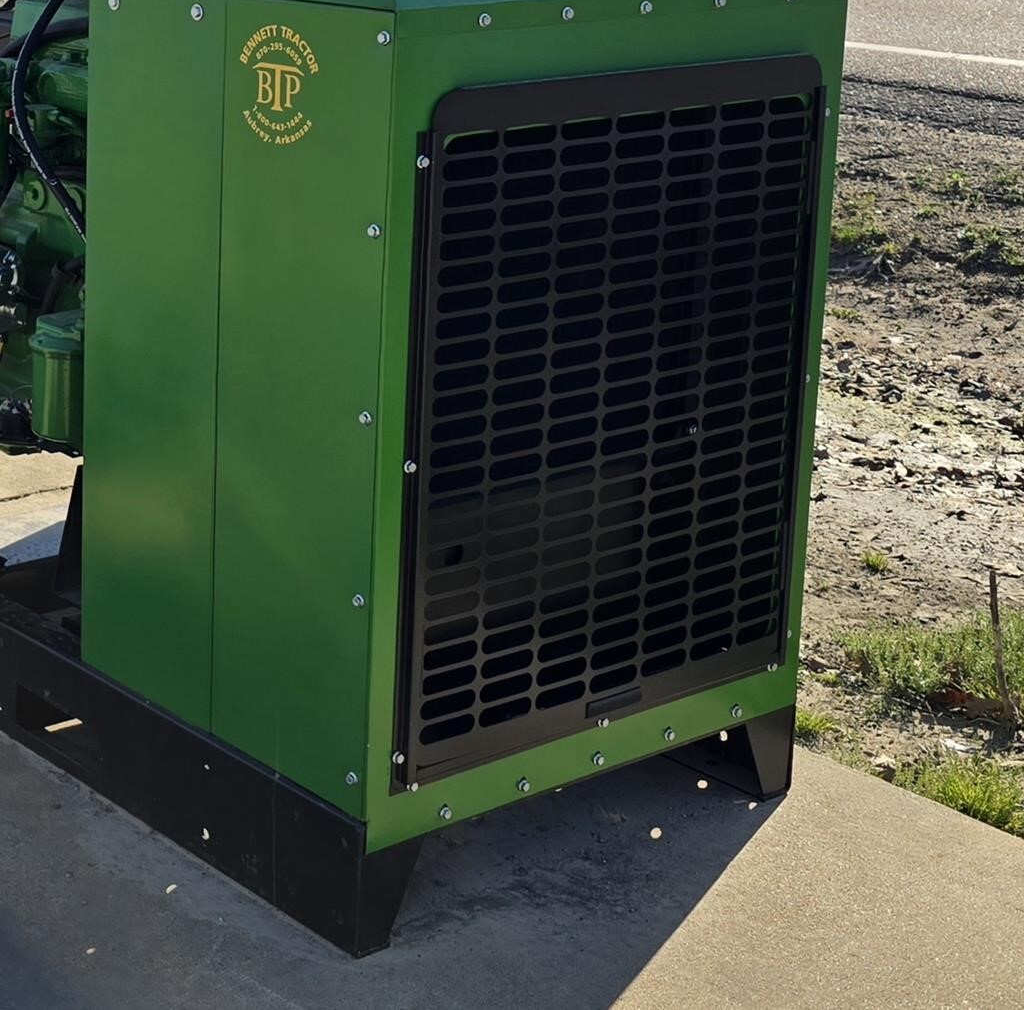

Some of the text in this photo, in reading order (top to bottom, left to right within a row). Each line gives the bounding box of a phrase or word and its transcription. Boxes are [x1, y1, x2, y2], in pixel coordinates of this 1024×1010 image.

[239, 24, 320, 75] BENNETT TRACTOR
[242, 109, 313, 145] Aubrey, Arkansas
